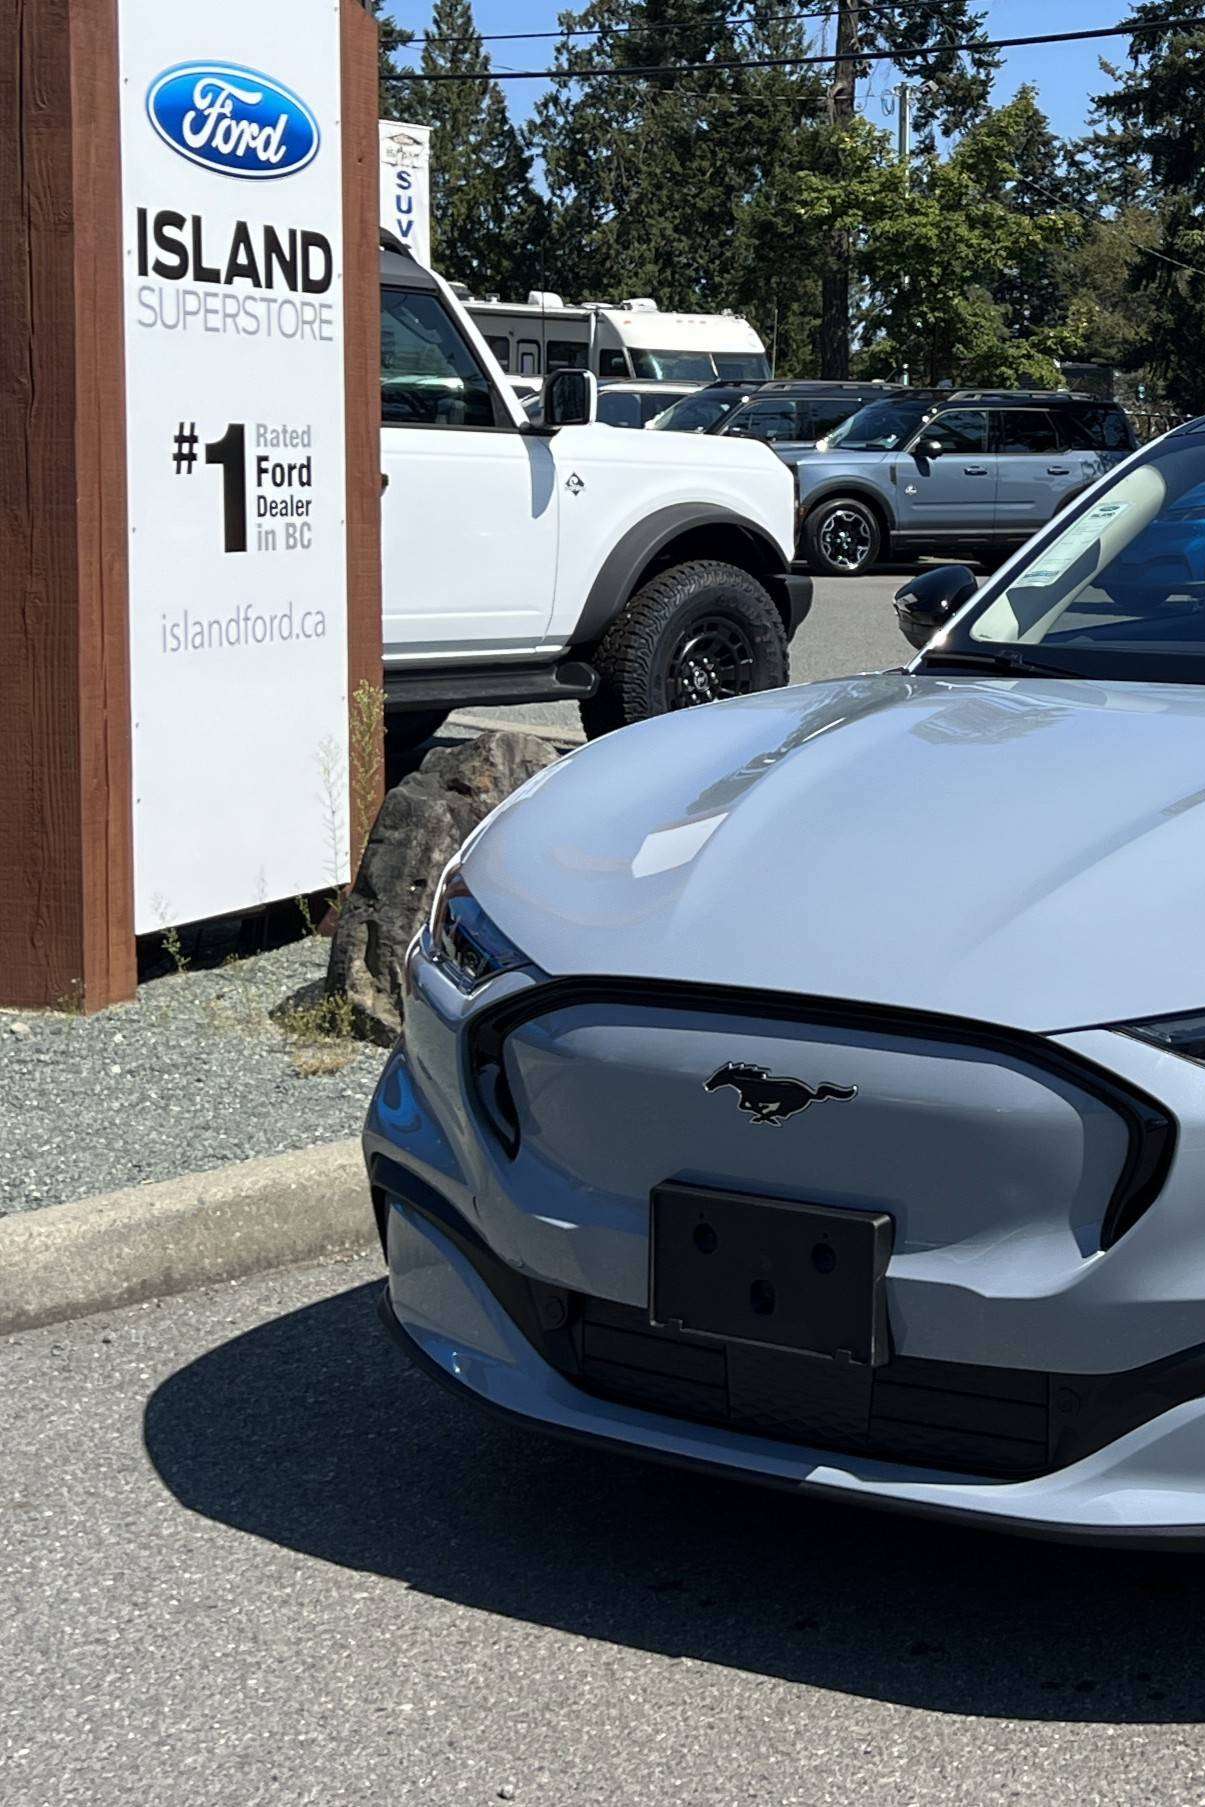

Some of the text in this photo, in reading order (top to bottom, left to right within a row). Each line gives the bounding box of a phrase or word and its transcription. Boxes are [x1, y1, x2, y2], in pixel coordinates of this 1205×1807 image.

[182, 77, 288, 164] Ford
[395, 170, 414, 238] SUV
[137, 207, 333, 294] ISLAND
[137, 285, 333, 341] SUPERSTORE
[256, 423, 312, 448] Rated
[172, 421, 248, 553] #1
[256, 455, 312, 487] Ford
[256, 494, 312, 518] Dealer
[256, 521, 312, 551] in BC
[162, 601, 326, 653] islandford.ca
